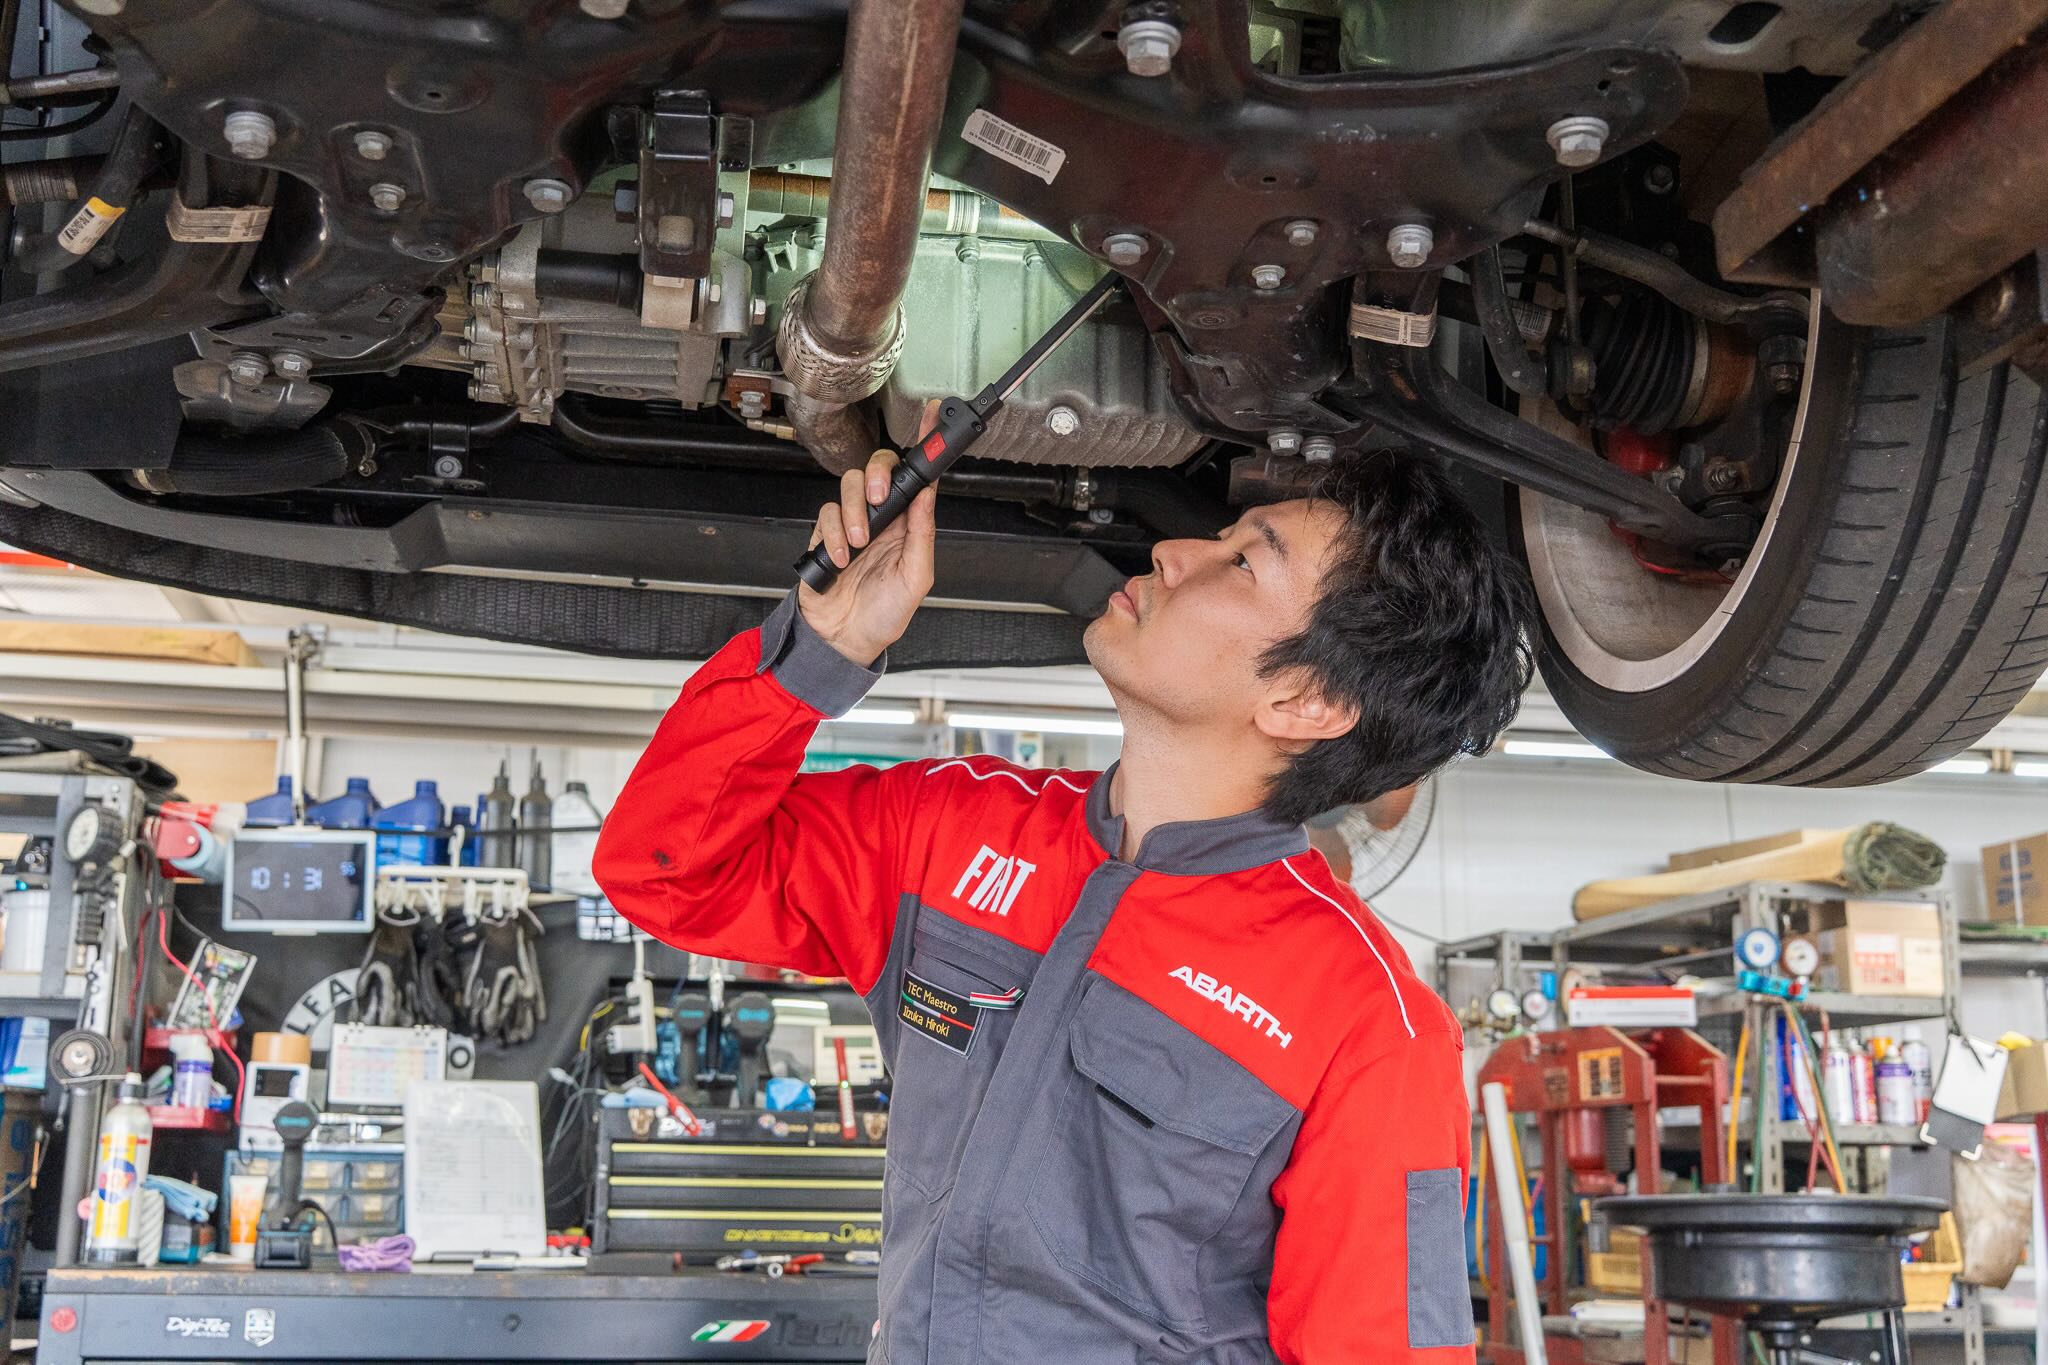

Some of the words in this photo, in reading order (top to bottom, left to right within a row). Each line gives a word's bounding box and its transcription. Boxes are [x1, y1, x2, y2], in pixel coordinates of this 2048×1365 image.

[951, 844, 1037, 916] FIAT
[907, 981, 922, 998] TEC
[923, 990, 958, 1015] Maestro
[1168, 966, 1292, 1049] ABARTH
[925, 1017, 950, 1037] Hiroki
